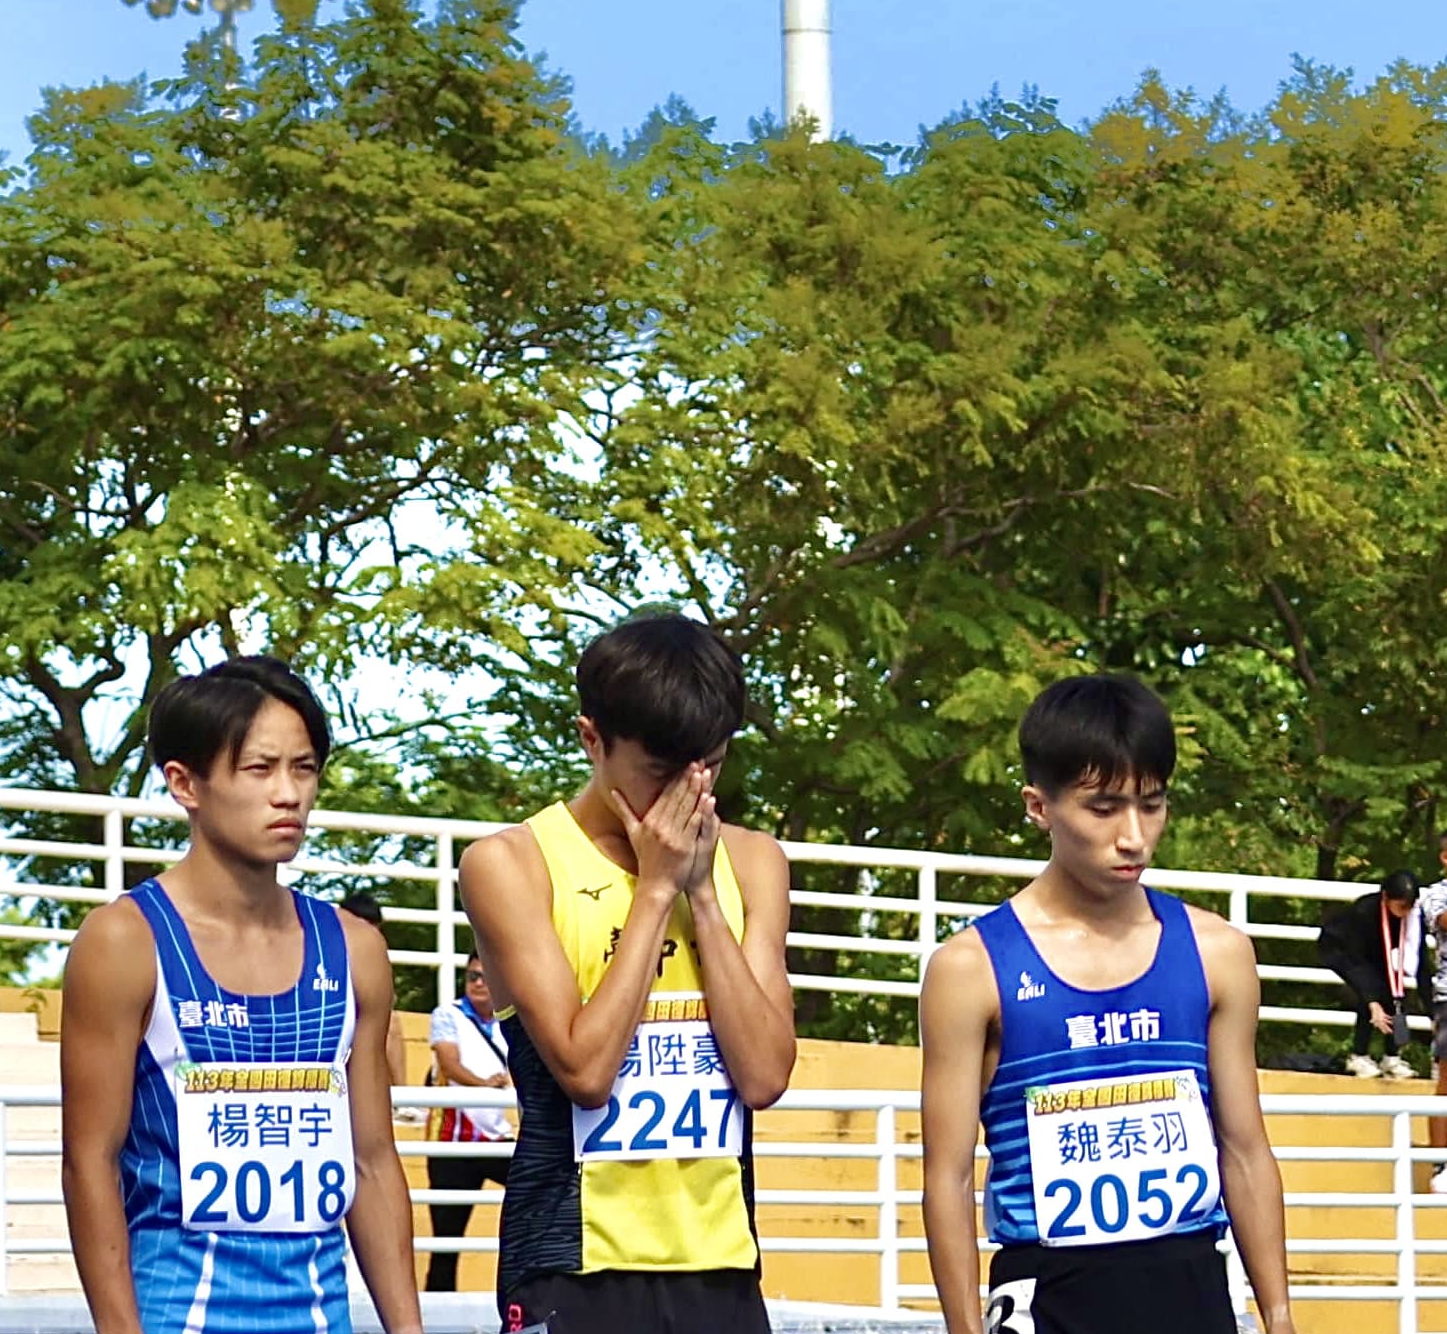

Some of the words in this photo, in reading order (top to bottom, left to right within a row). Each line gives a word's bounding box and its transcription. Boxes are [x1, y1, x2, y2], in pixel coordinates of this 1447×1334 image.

[178, 1000, 250, 1028] 臺北市
[1065, 1008, 1159, 1049] 臺北市
[208, 1102, 332, 1147] 楊智宇
[582, 1089, 737, 1153] 2247
[1057, 1111, 1188, 1165] 魏泰羽
[190, 1160, 346, 1223] 2018
[1044, 1163, 1207, 1238] 2052
